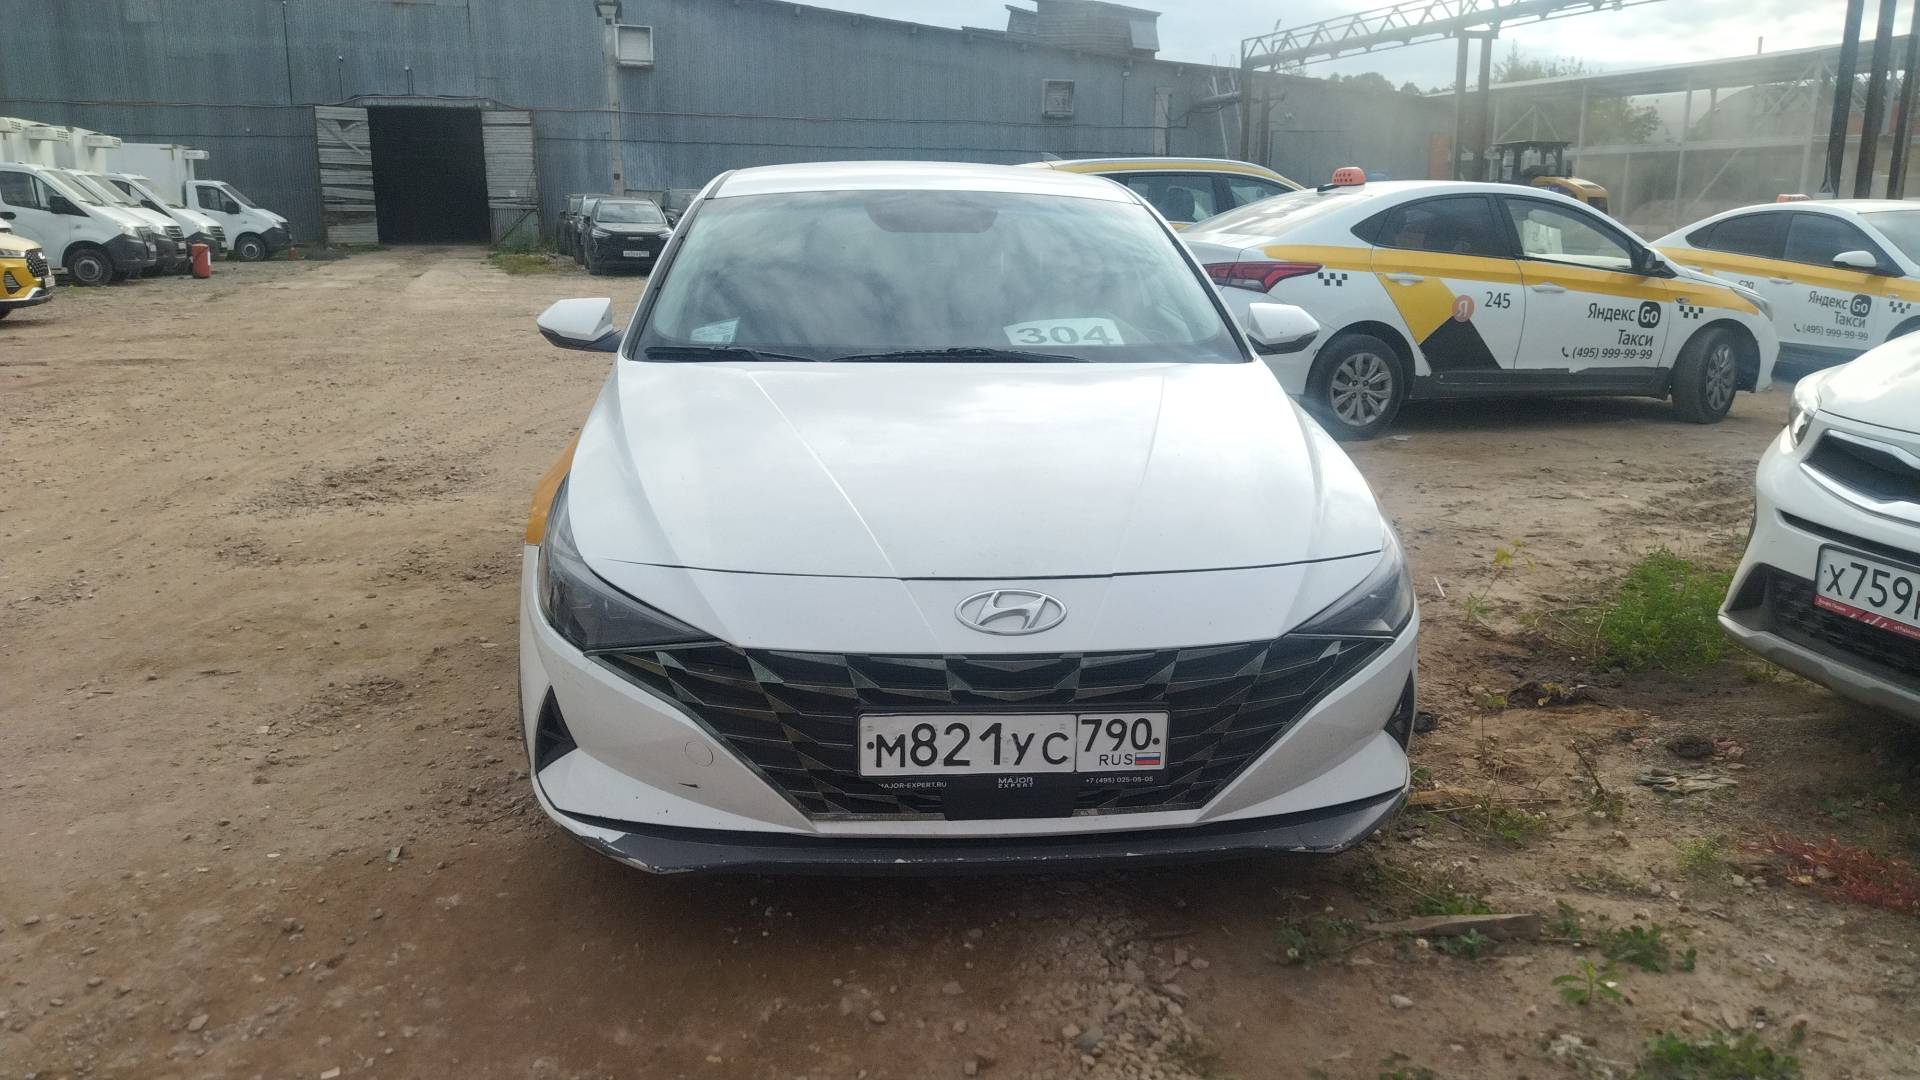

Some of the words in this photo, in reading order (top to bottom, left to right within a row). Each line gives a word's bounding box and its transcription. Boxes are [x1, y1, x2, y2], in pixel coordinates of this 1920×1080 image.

[1484, 291, 1511, 309] 245
[1808, 290, 1849, 309] Яндекс
[1588, 302, 1636, 322] Яндекс
[1834, 310, 1866, 329] Такси
[1016, 325, 1114, 345] 304
[1618, 329, 1654, 347] Такси
[1802, 323, 1824, 335] (495)
[1826, 328, 1869, 341] 999-99-99
[1572, 347, 1599, 359] (495)
[1601, 348, 1653, 360] 999-99-99
[1825, 562, 1920, 620] Х759
[1081, 718, 1152, 752] 790
[1098, 753, 1134, 766] RUS
[998, 776, 1034, 784] MAJOR
